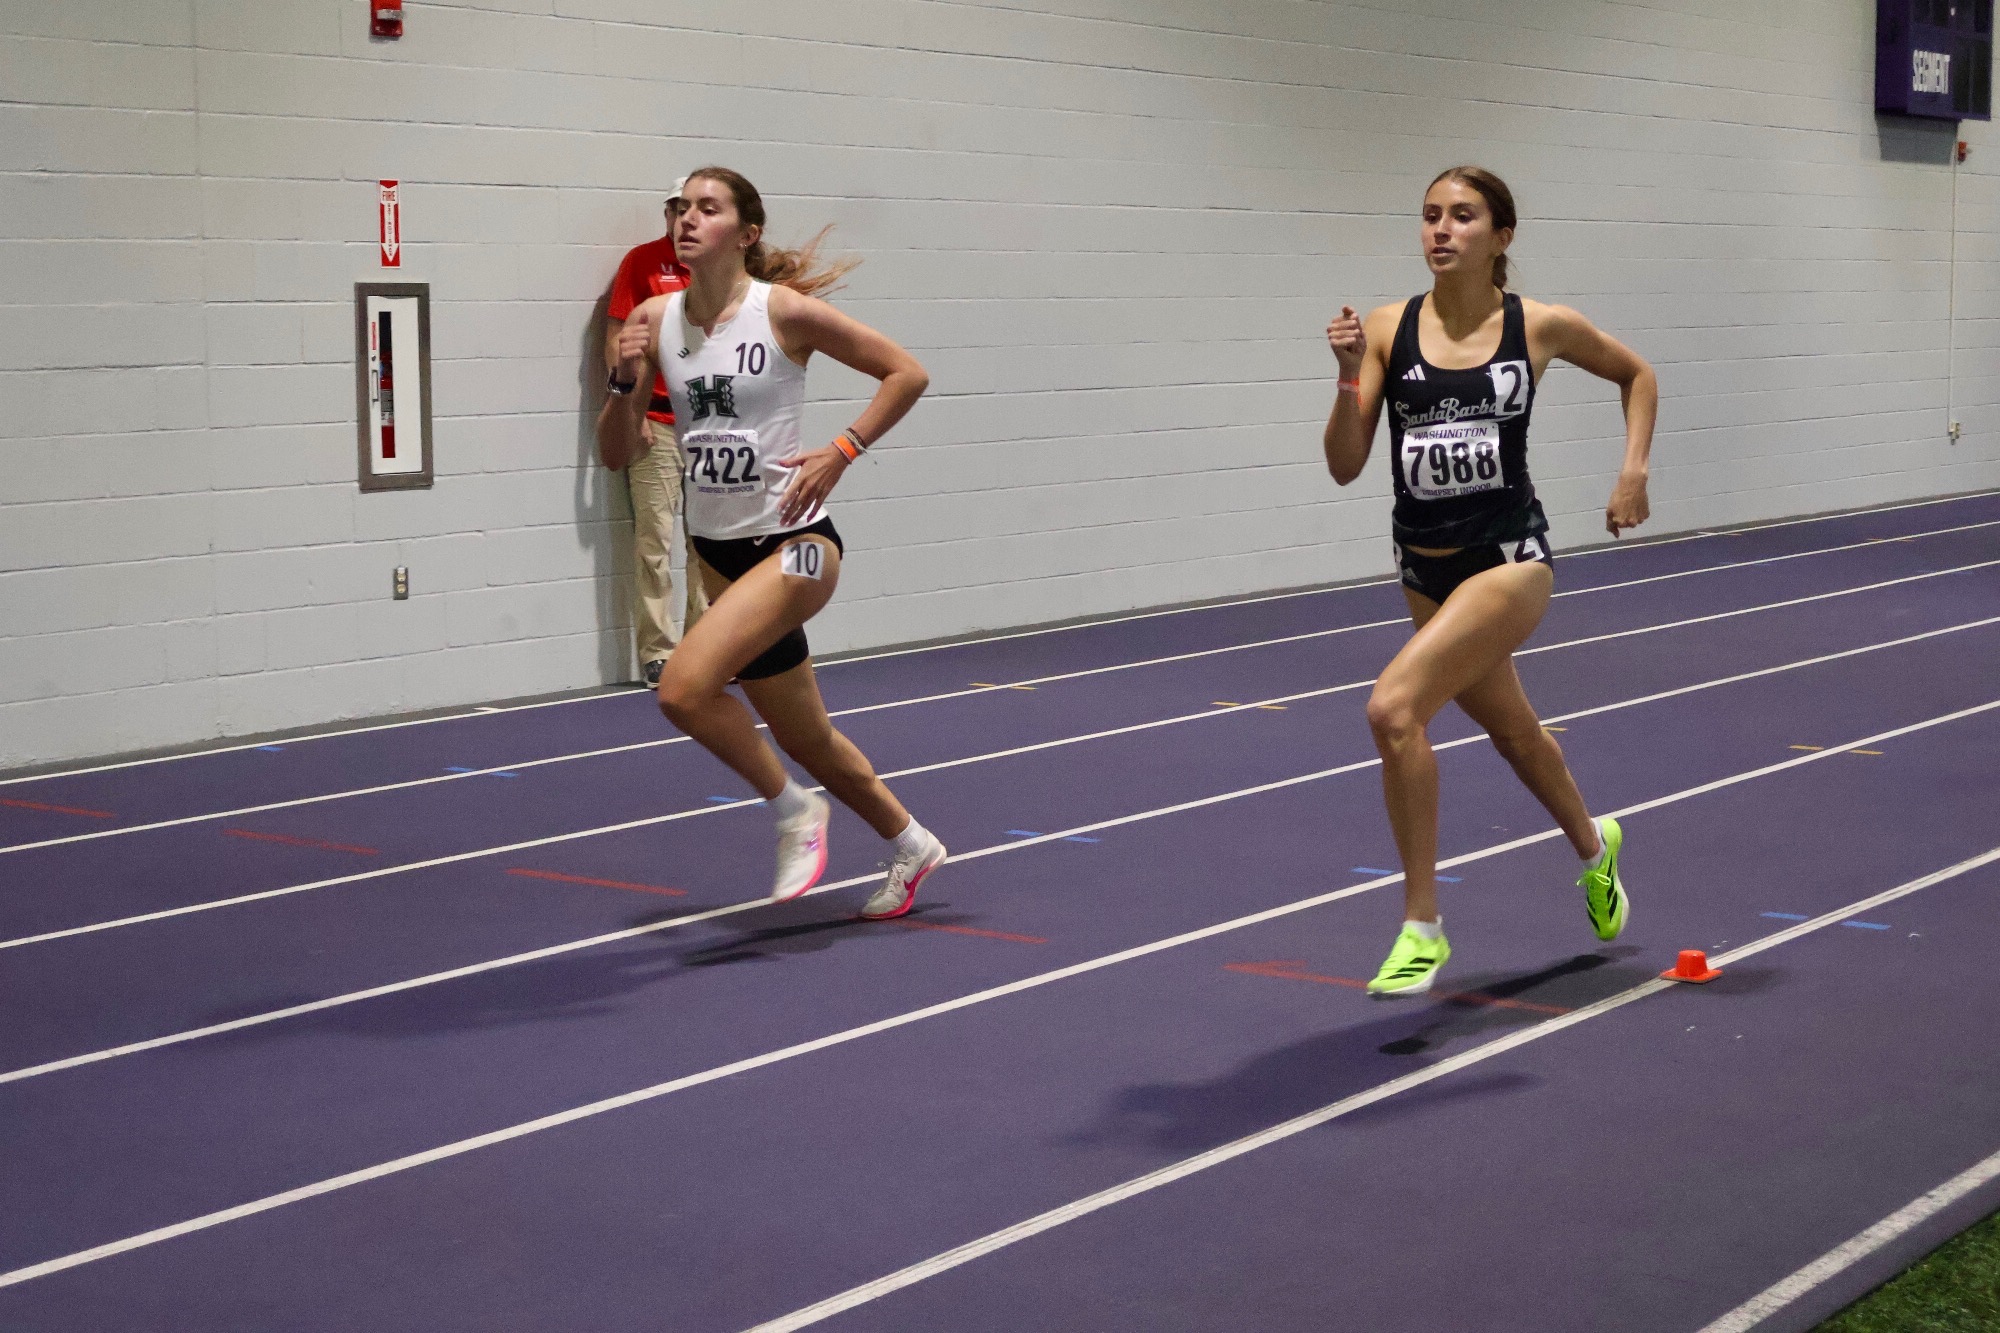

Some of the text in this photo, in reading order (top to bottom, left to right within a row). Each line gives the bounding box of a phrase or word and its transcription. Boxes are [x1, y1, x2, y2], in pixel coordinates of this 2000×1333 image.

[1913, 49, 1950, 94] SEGMENT
[382, 190, 395, 201] FIRE
[735, 342, 766, 376] 10
[1500, 364, 1522, 413] 2
[1440, 397, 1497, 423] Barba
[688, 434, 748, 443] WASHINGTON
[1414, 427, 1488, 441] WASHINGTON
[687, 446, 760, 484] 7422
[1407, 441, 1497, 487] 7988
[790, 543, 819, 576] 10
